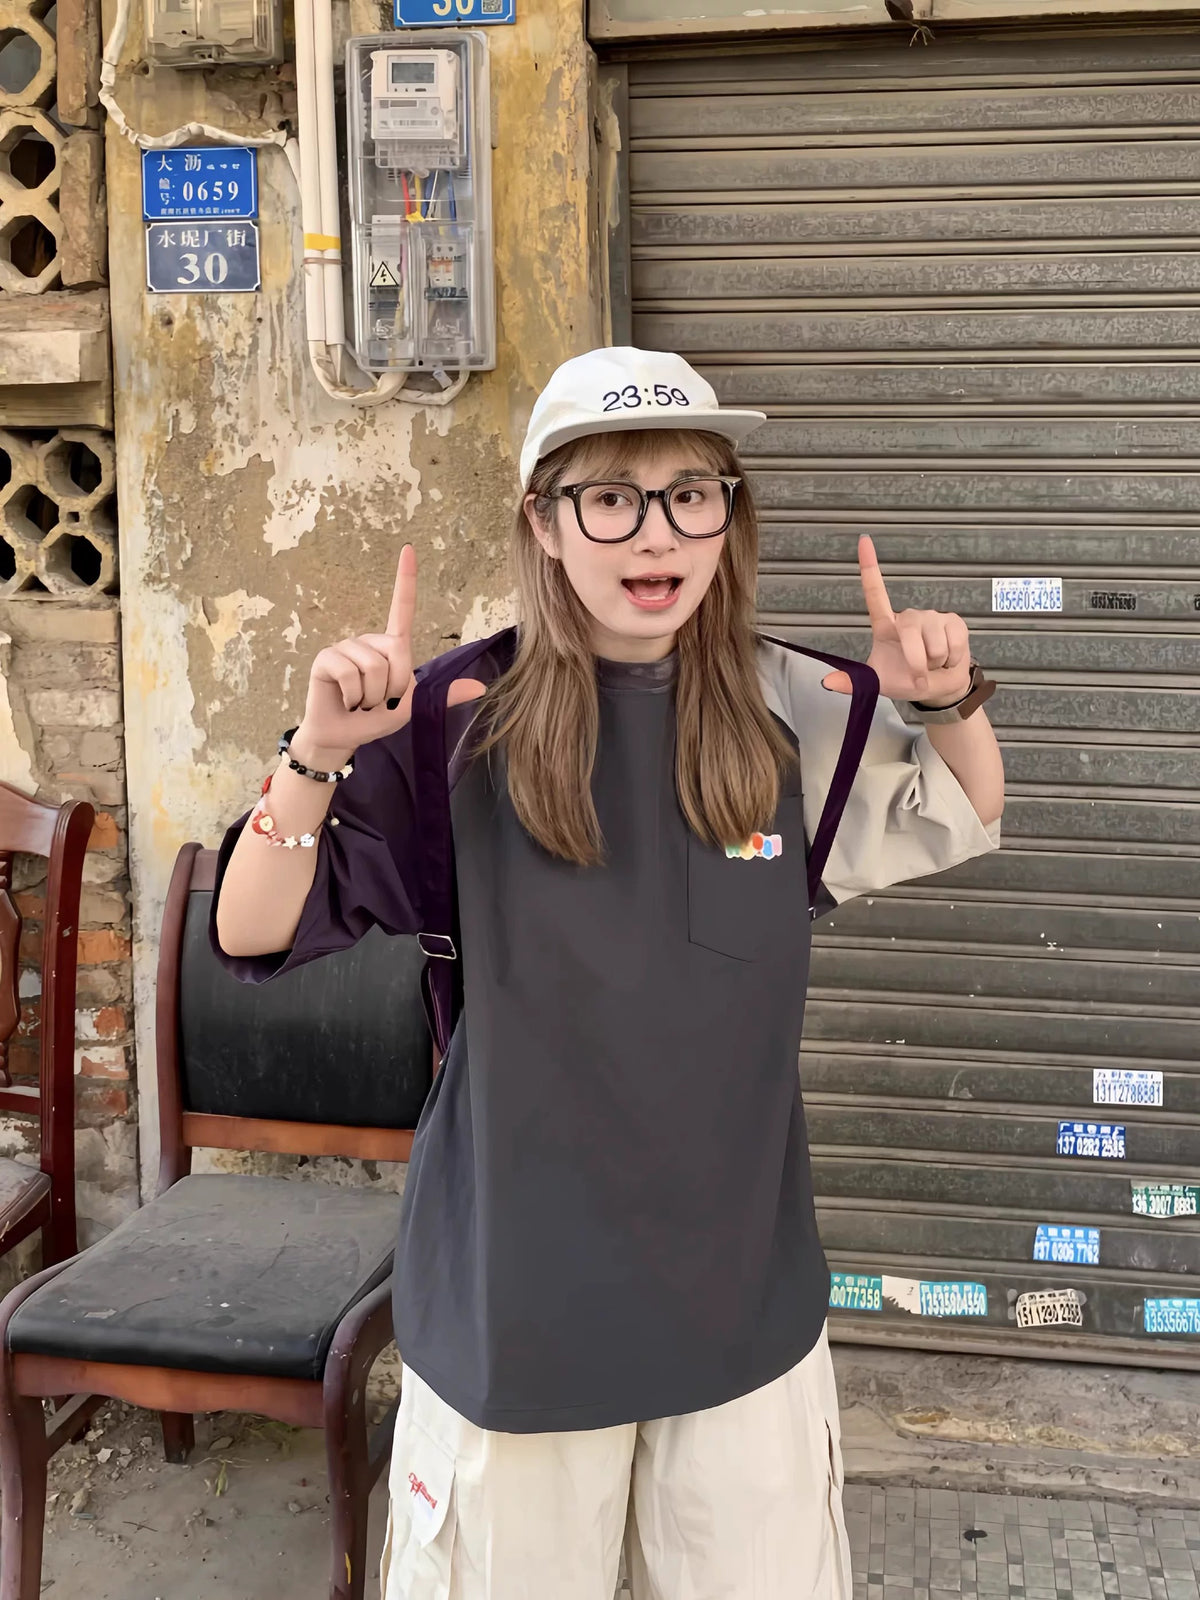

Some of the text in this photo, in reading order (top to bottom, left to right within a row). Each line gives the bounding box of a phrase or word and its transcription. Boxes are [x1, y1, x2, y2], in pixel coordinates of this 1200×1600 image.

[182, 180, 239, 202] 0659
[176, 252, 229, 285] 30
[602, 384, 690, 412] 23:59
